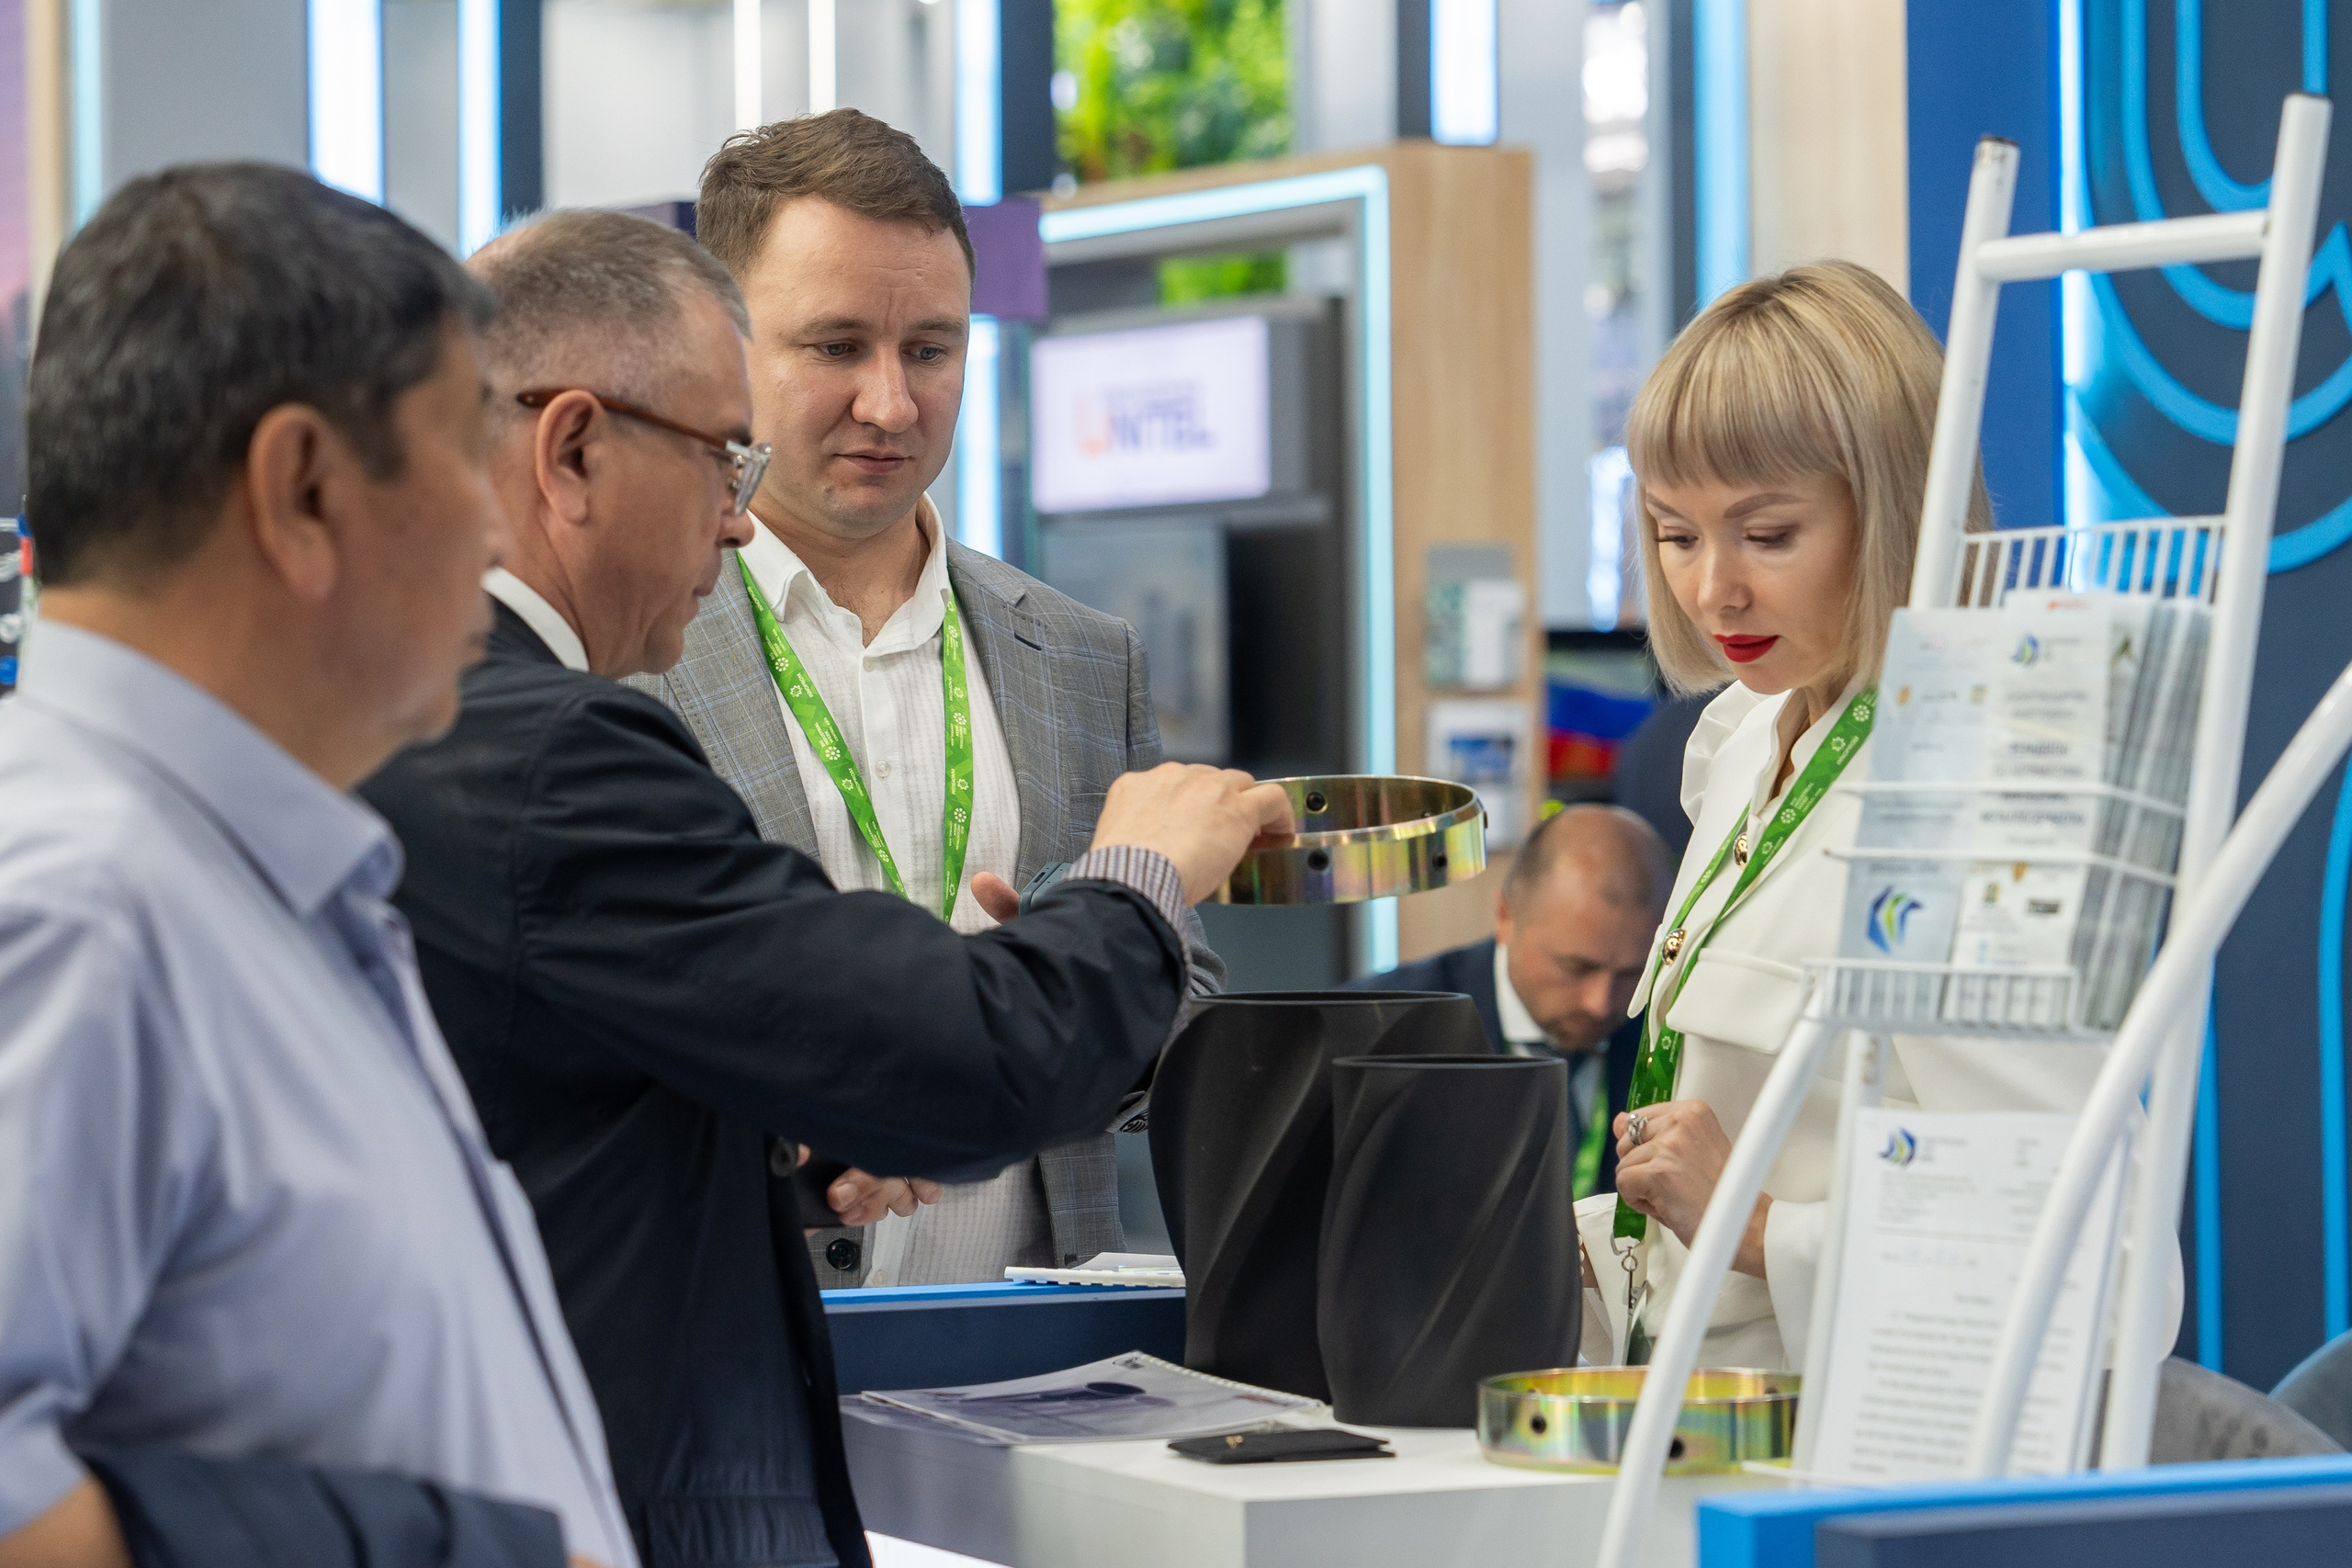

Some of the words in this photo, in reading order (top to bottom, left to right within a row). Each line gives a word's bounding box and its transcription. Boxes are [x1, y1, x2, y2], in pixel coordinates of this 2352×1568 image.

[747, 586, 763, 612] INNOPROM
[797, 672, 813, 698] INNOPROM
[1837, 736, 1860, 765] INNOPROM
[848, 768, 864, 797] INNOPROM
